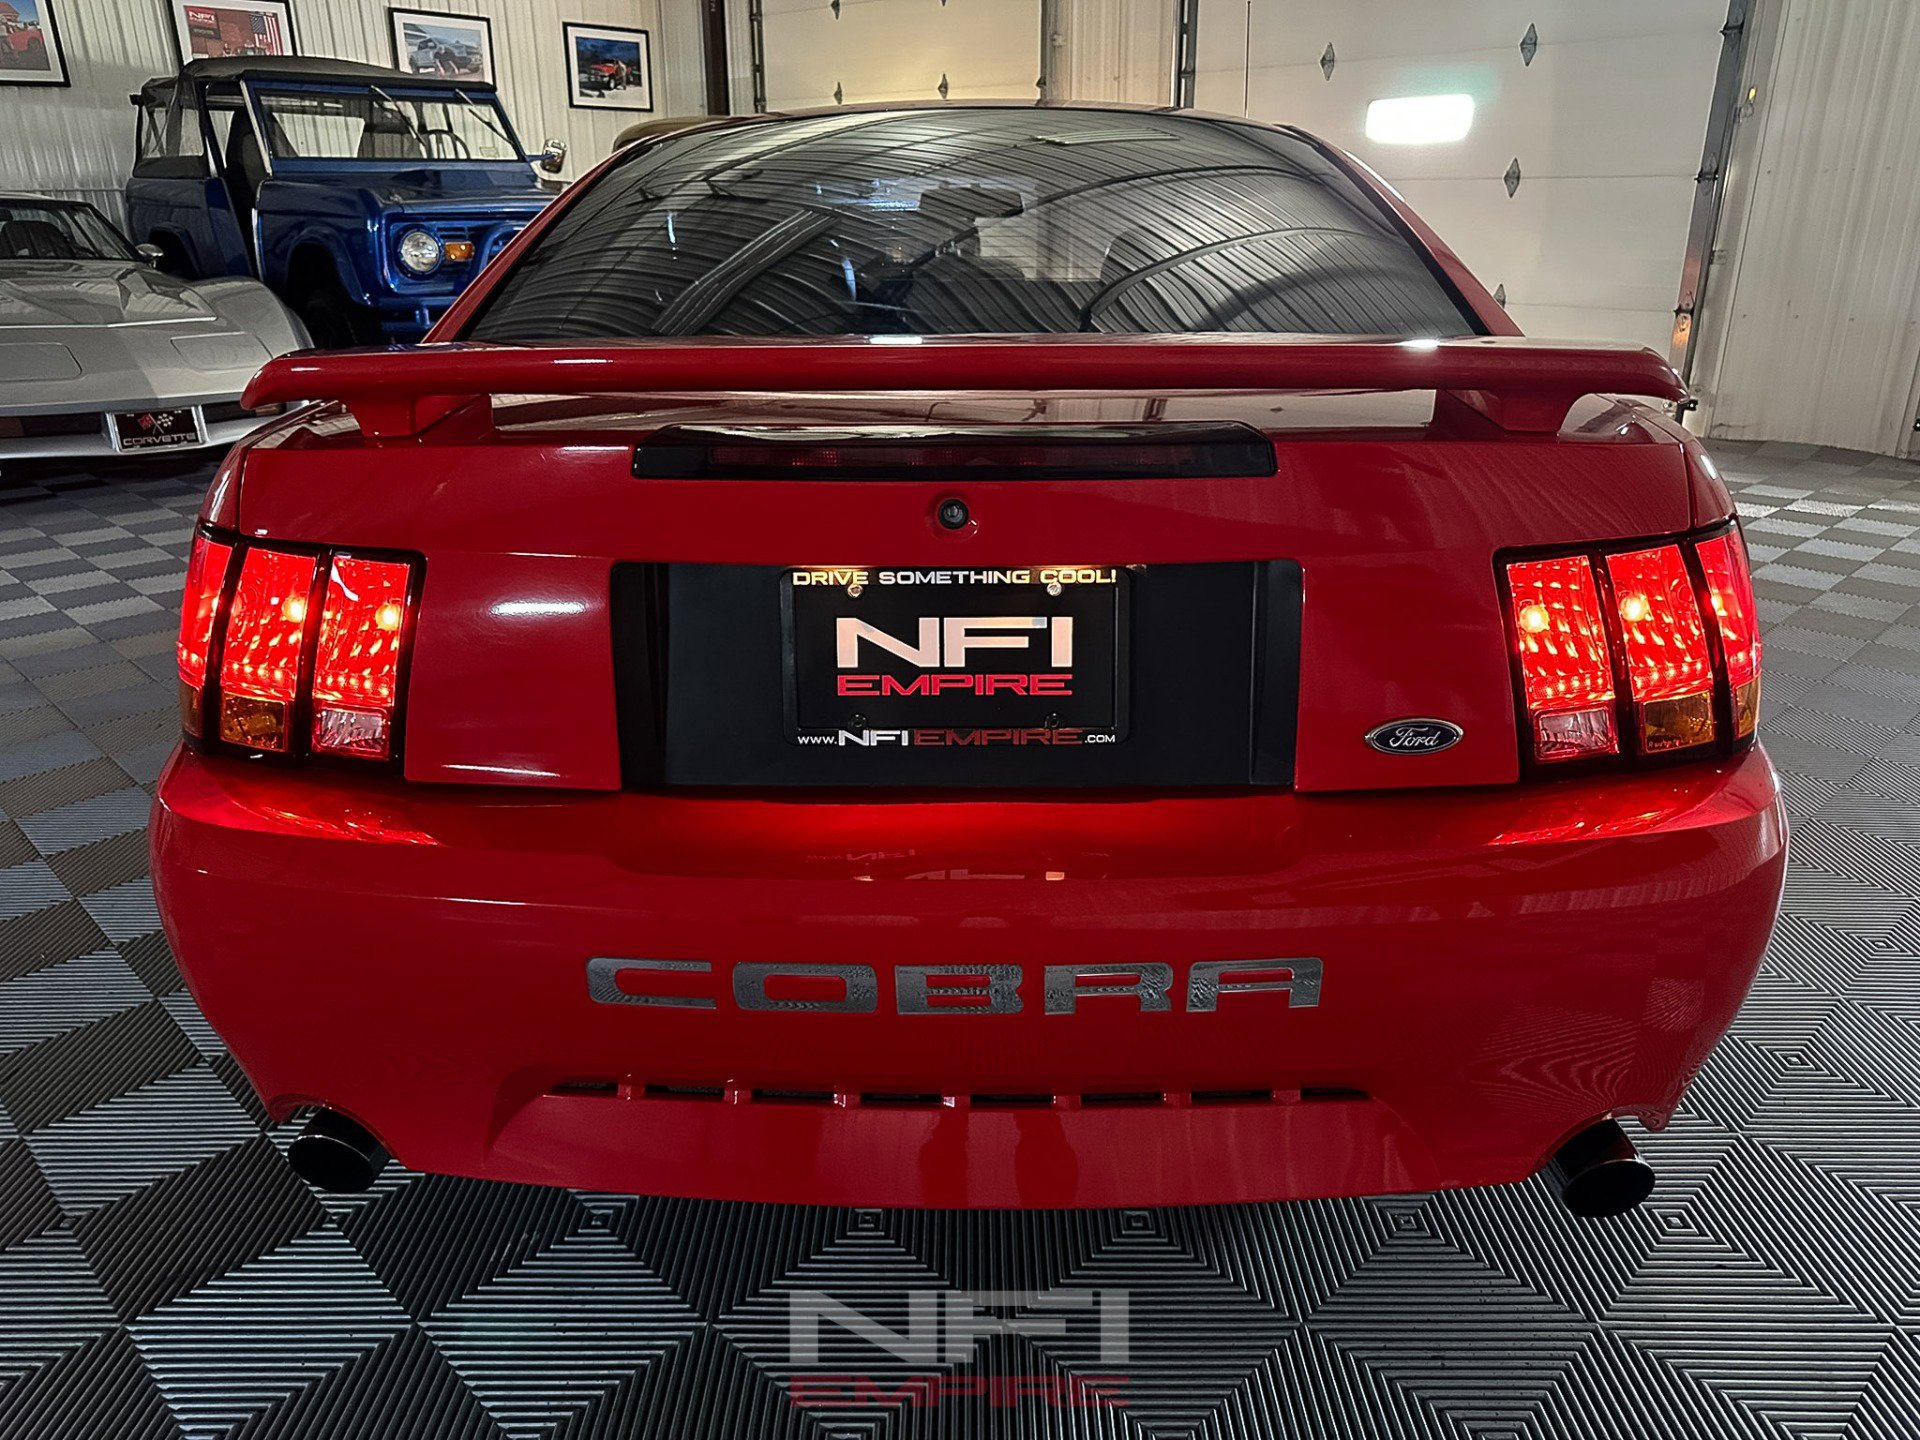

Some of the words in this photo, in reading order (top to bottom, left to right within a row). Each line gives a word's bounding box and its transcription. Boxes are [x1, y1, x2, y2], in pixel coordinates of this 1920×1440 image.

[123, 432, 196, 446] CORVETTE
[792, 570, 869, 586] DRIVE
[878, 570, 1030, 585] SOMETHING
[1039, 568, 1117, 584] COOL!
[836, 616, 1073, 668] NFI
[836, 673, 1073, 696] EMPIRE
[1389, 726, 1441, 748] Ford
[586, 956, 1323, 1016] COBRA
